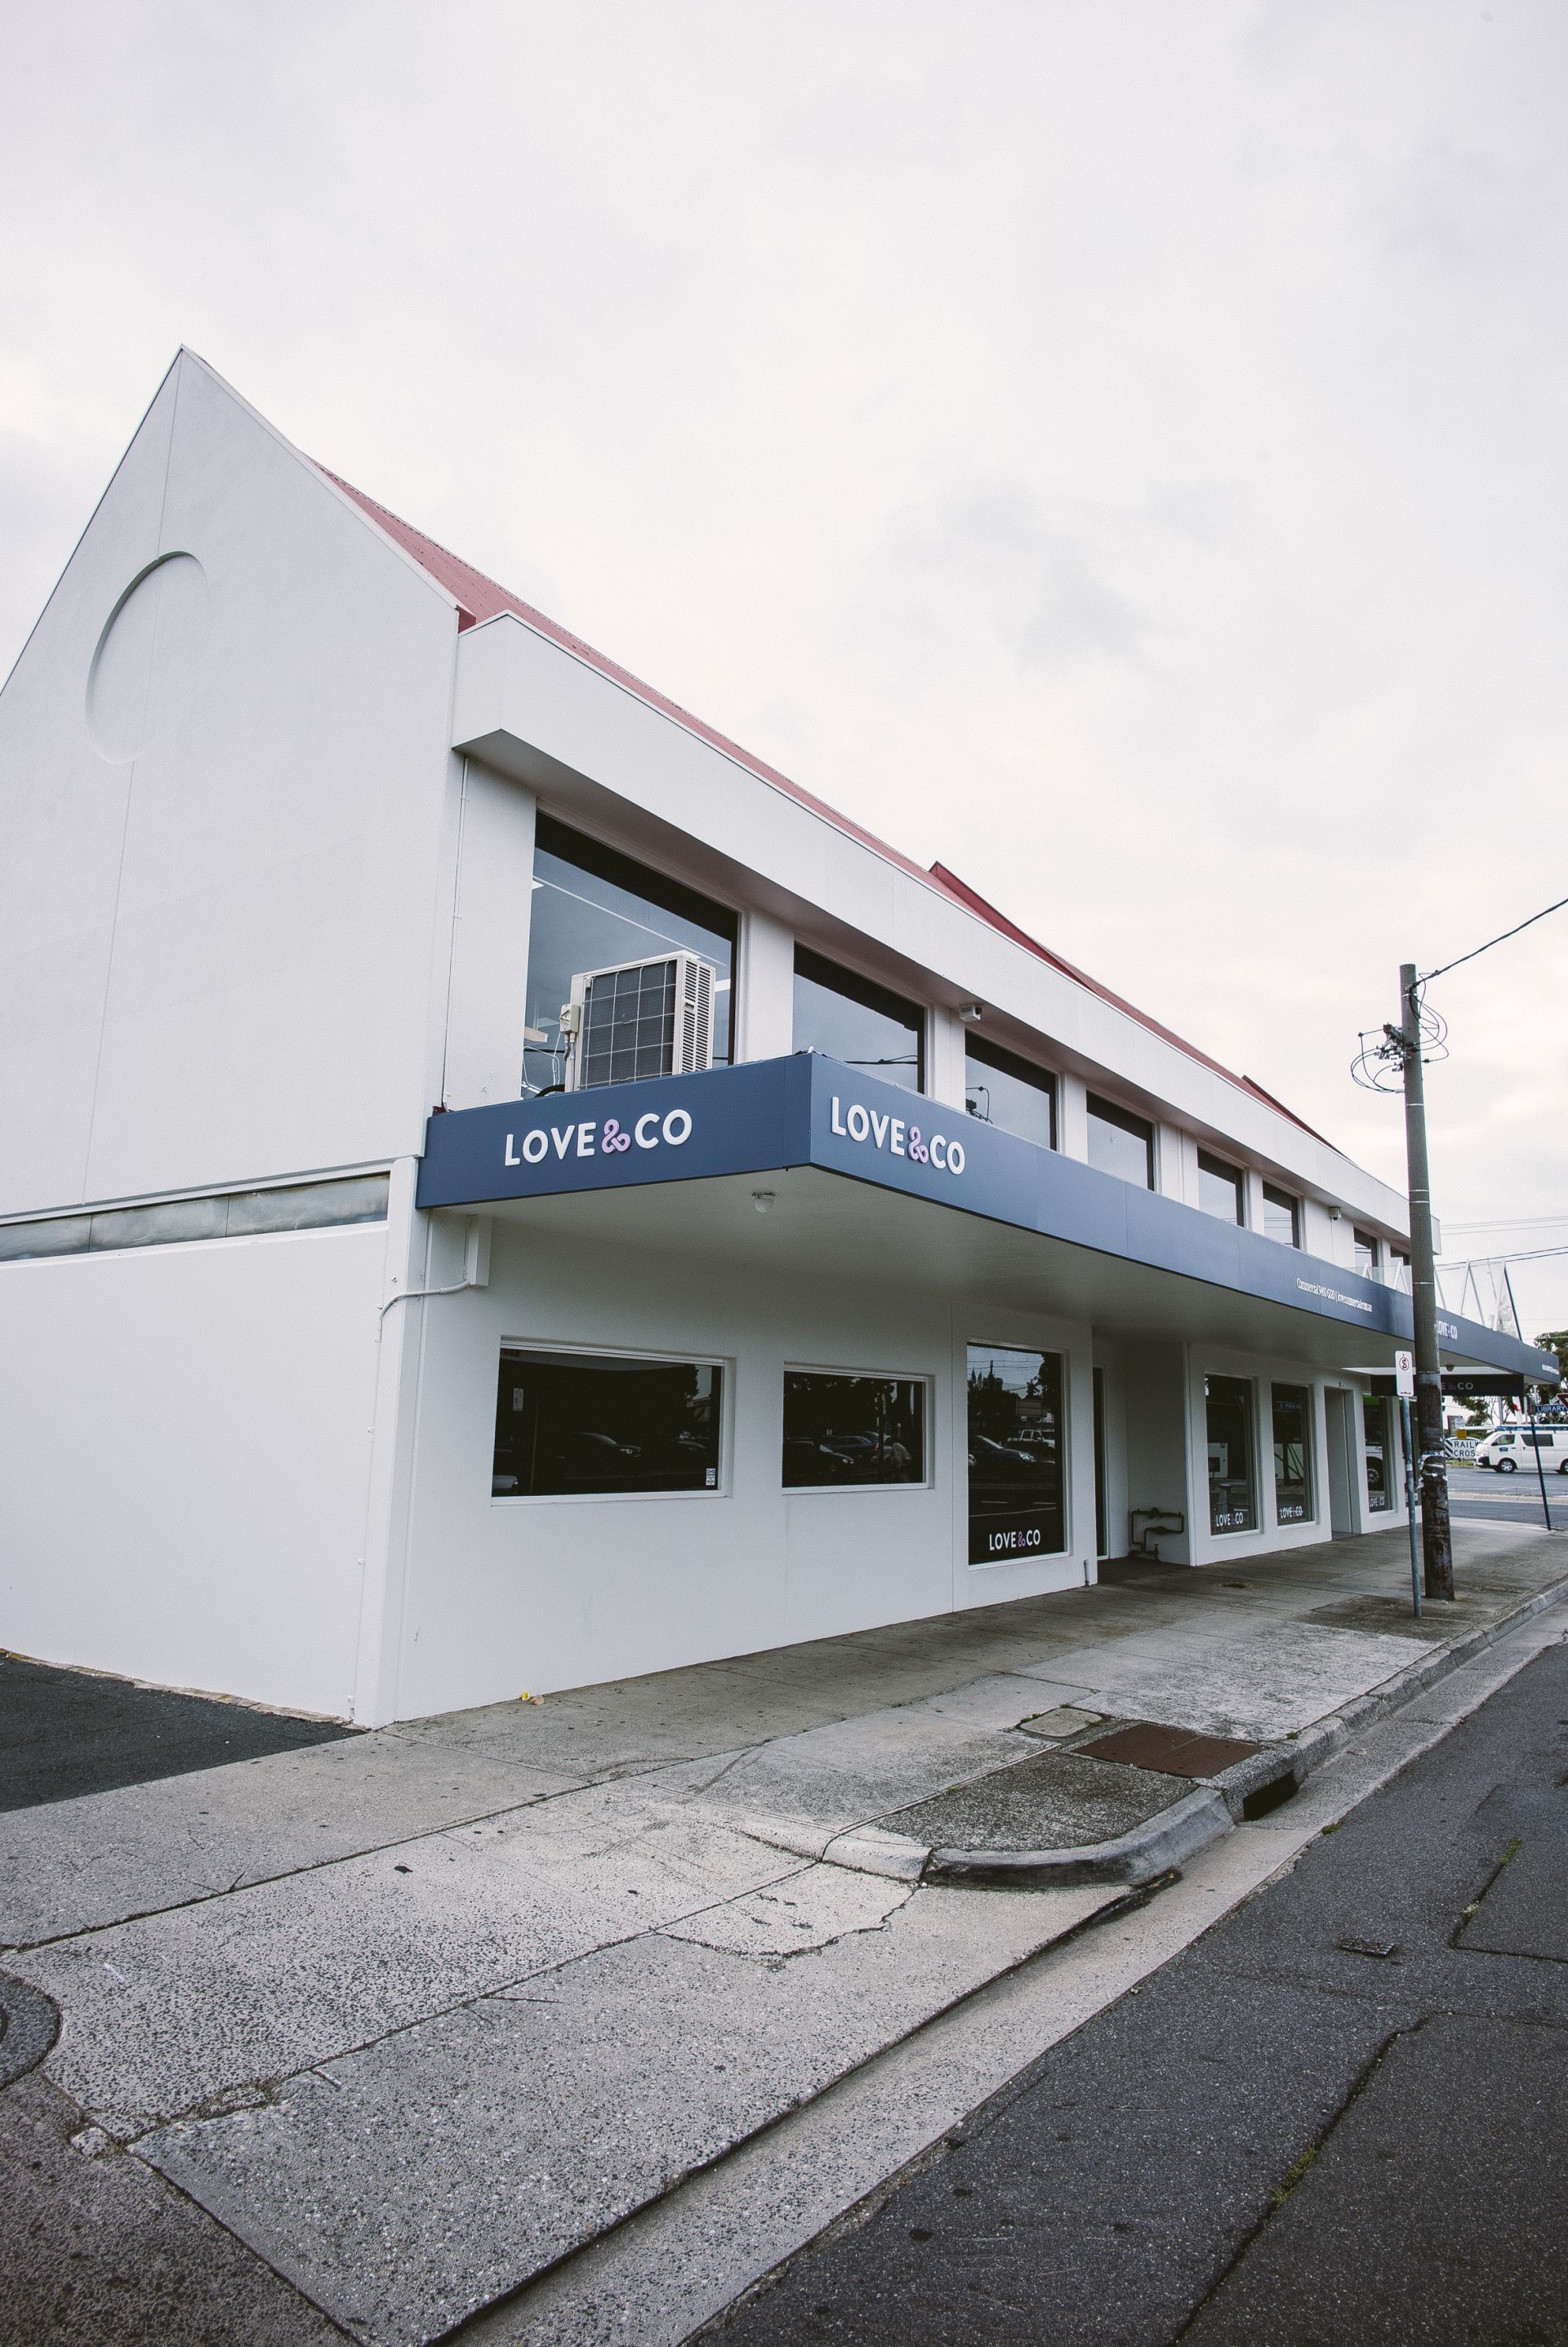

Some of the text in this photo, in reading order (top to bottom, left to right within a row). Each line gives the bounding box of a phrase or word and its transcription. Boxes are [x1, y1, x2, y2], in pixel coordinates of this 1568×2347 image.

[505, 1109, 693, 1166] LOVE&CO
[831, 1096, 965, 1175] LOVE&CO
[1454, 1441, 1480, 1449] RAILW
[1454, 1450, 1476, 1458] CROS
